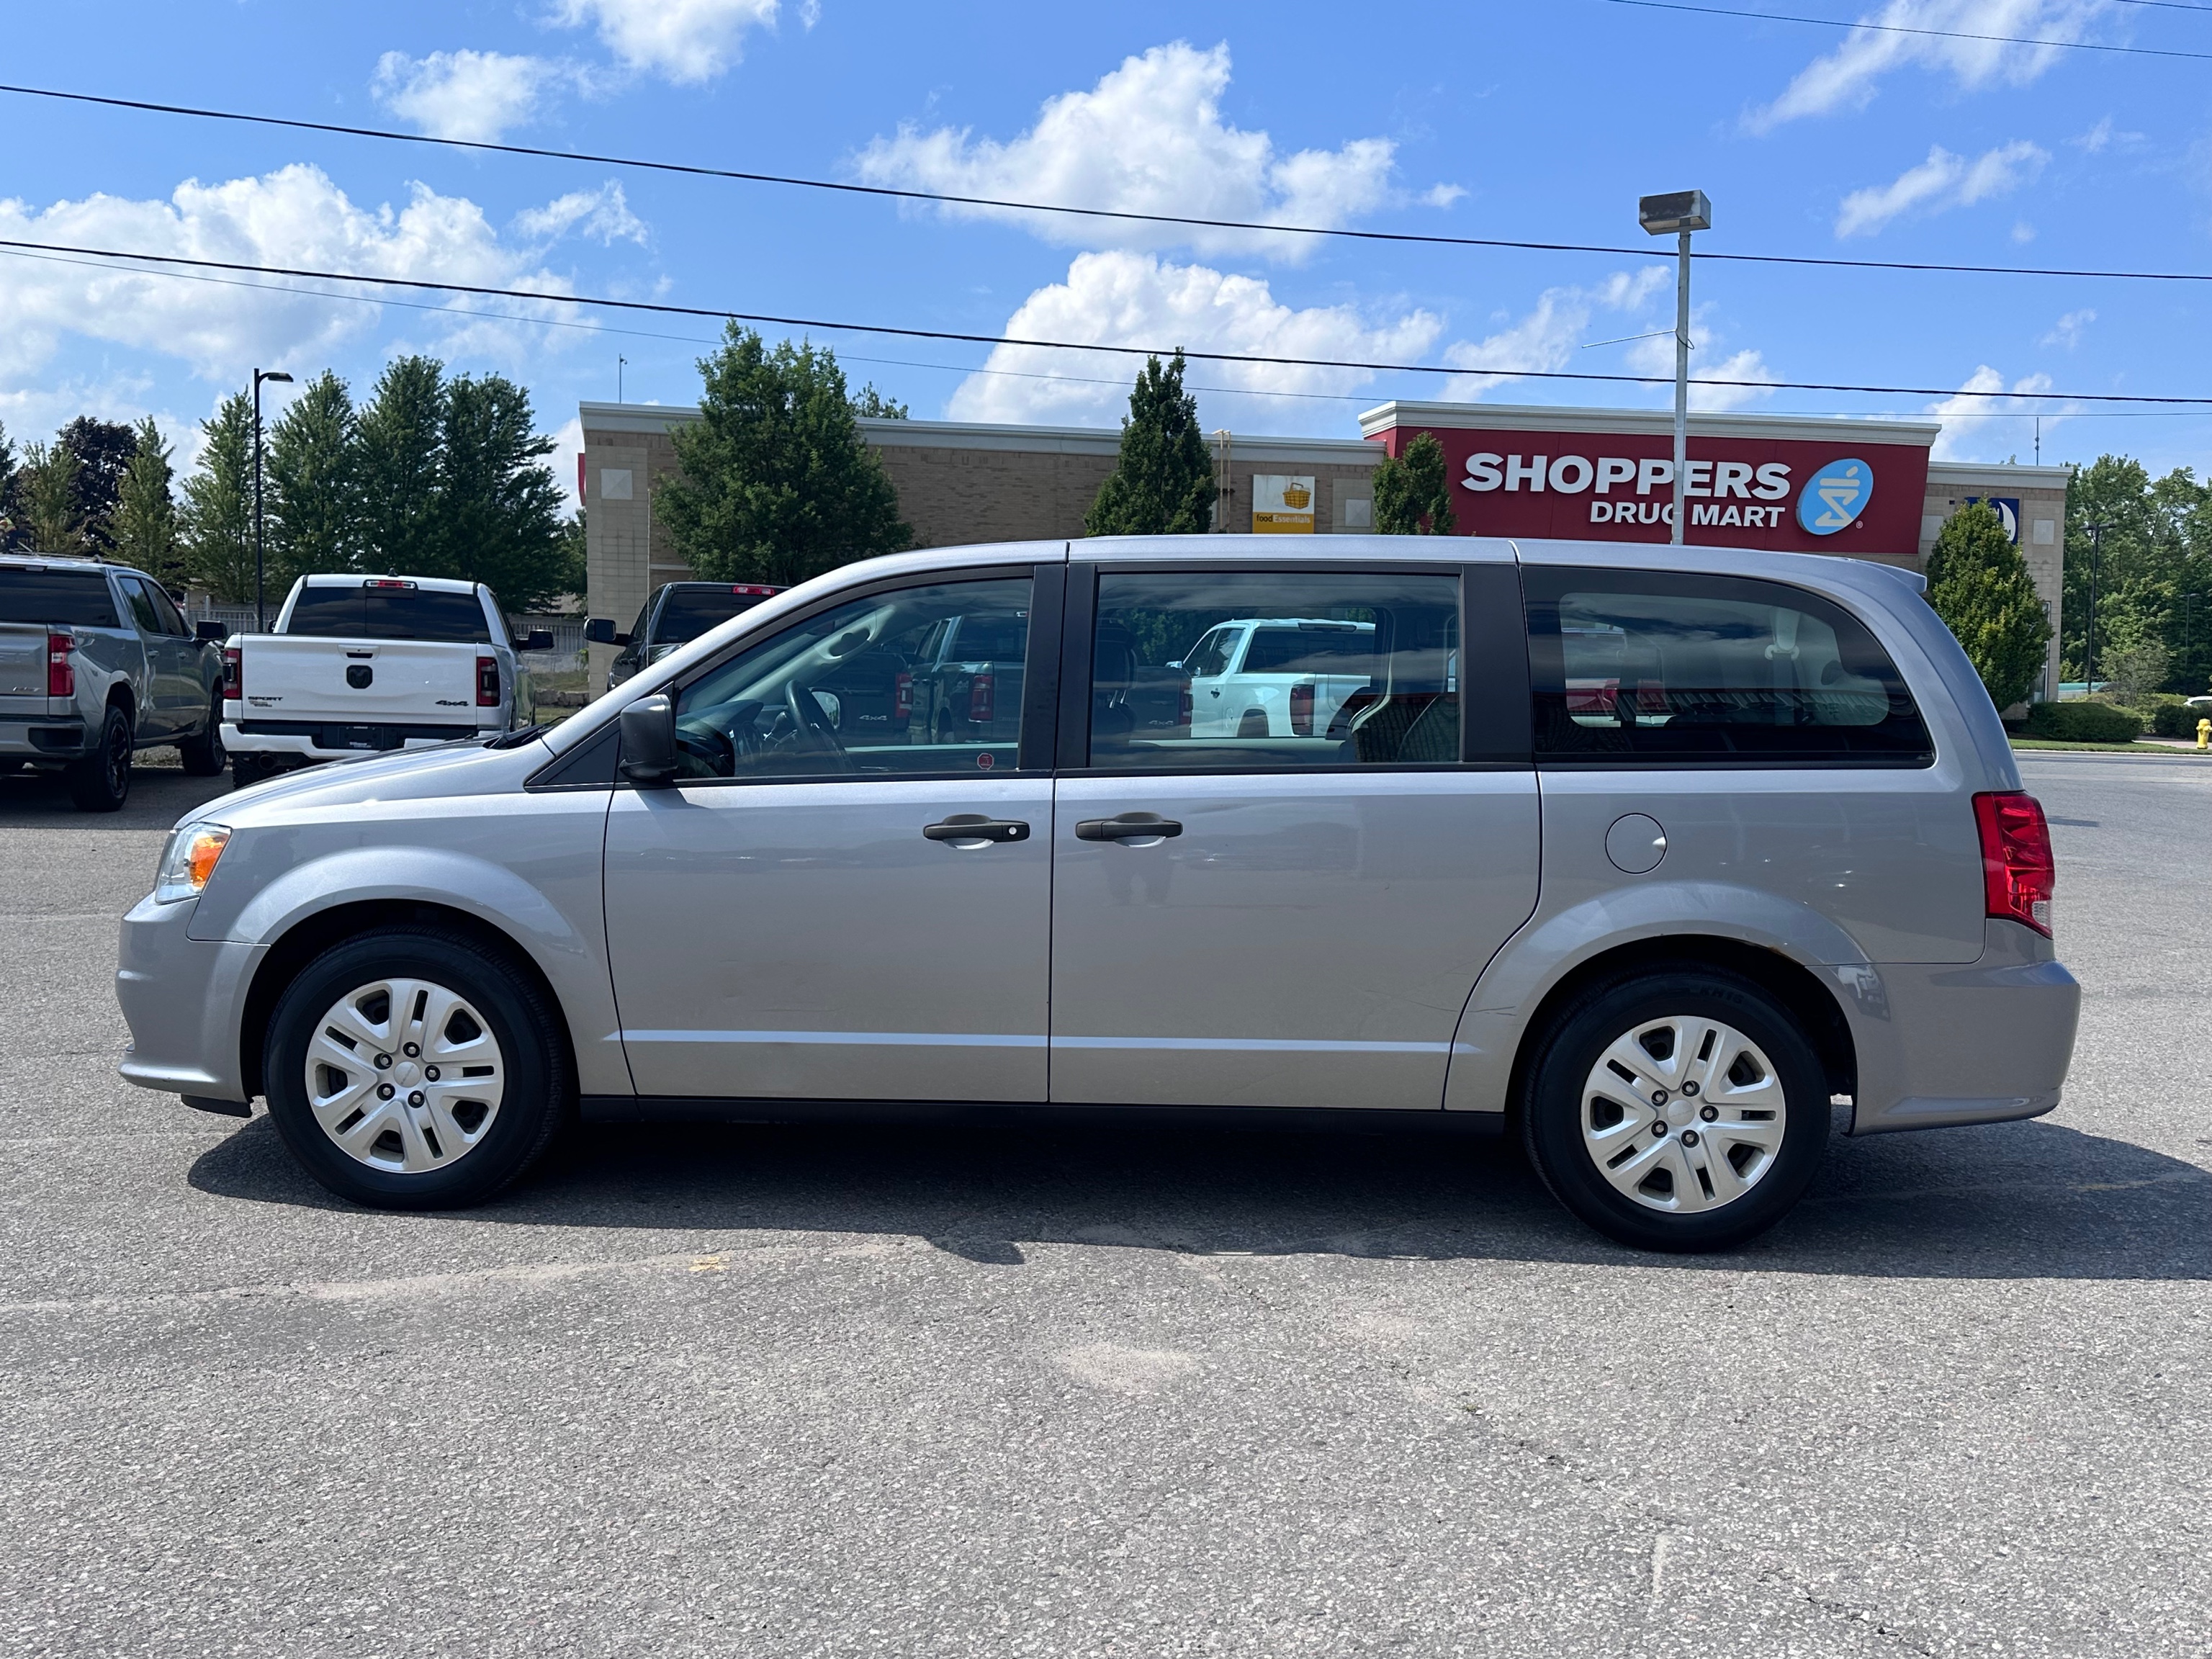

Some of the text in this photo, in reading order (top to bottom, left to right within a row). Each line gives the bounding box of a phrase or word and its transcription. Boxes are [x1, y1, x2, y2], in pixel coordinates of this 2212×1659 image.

[1460, 452, 1792, 500] SHOPPERS
[1256, 514, 1310, 524] foodEssentials
[1691, 504, 1786, 528] MART
